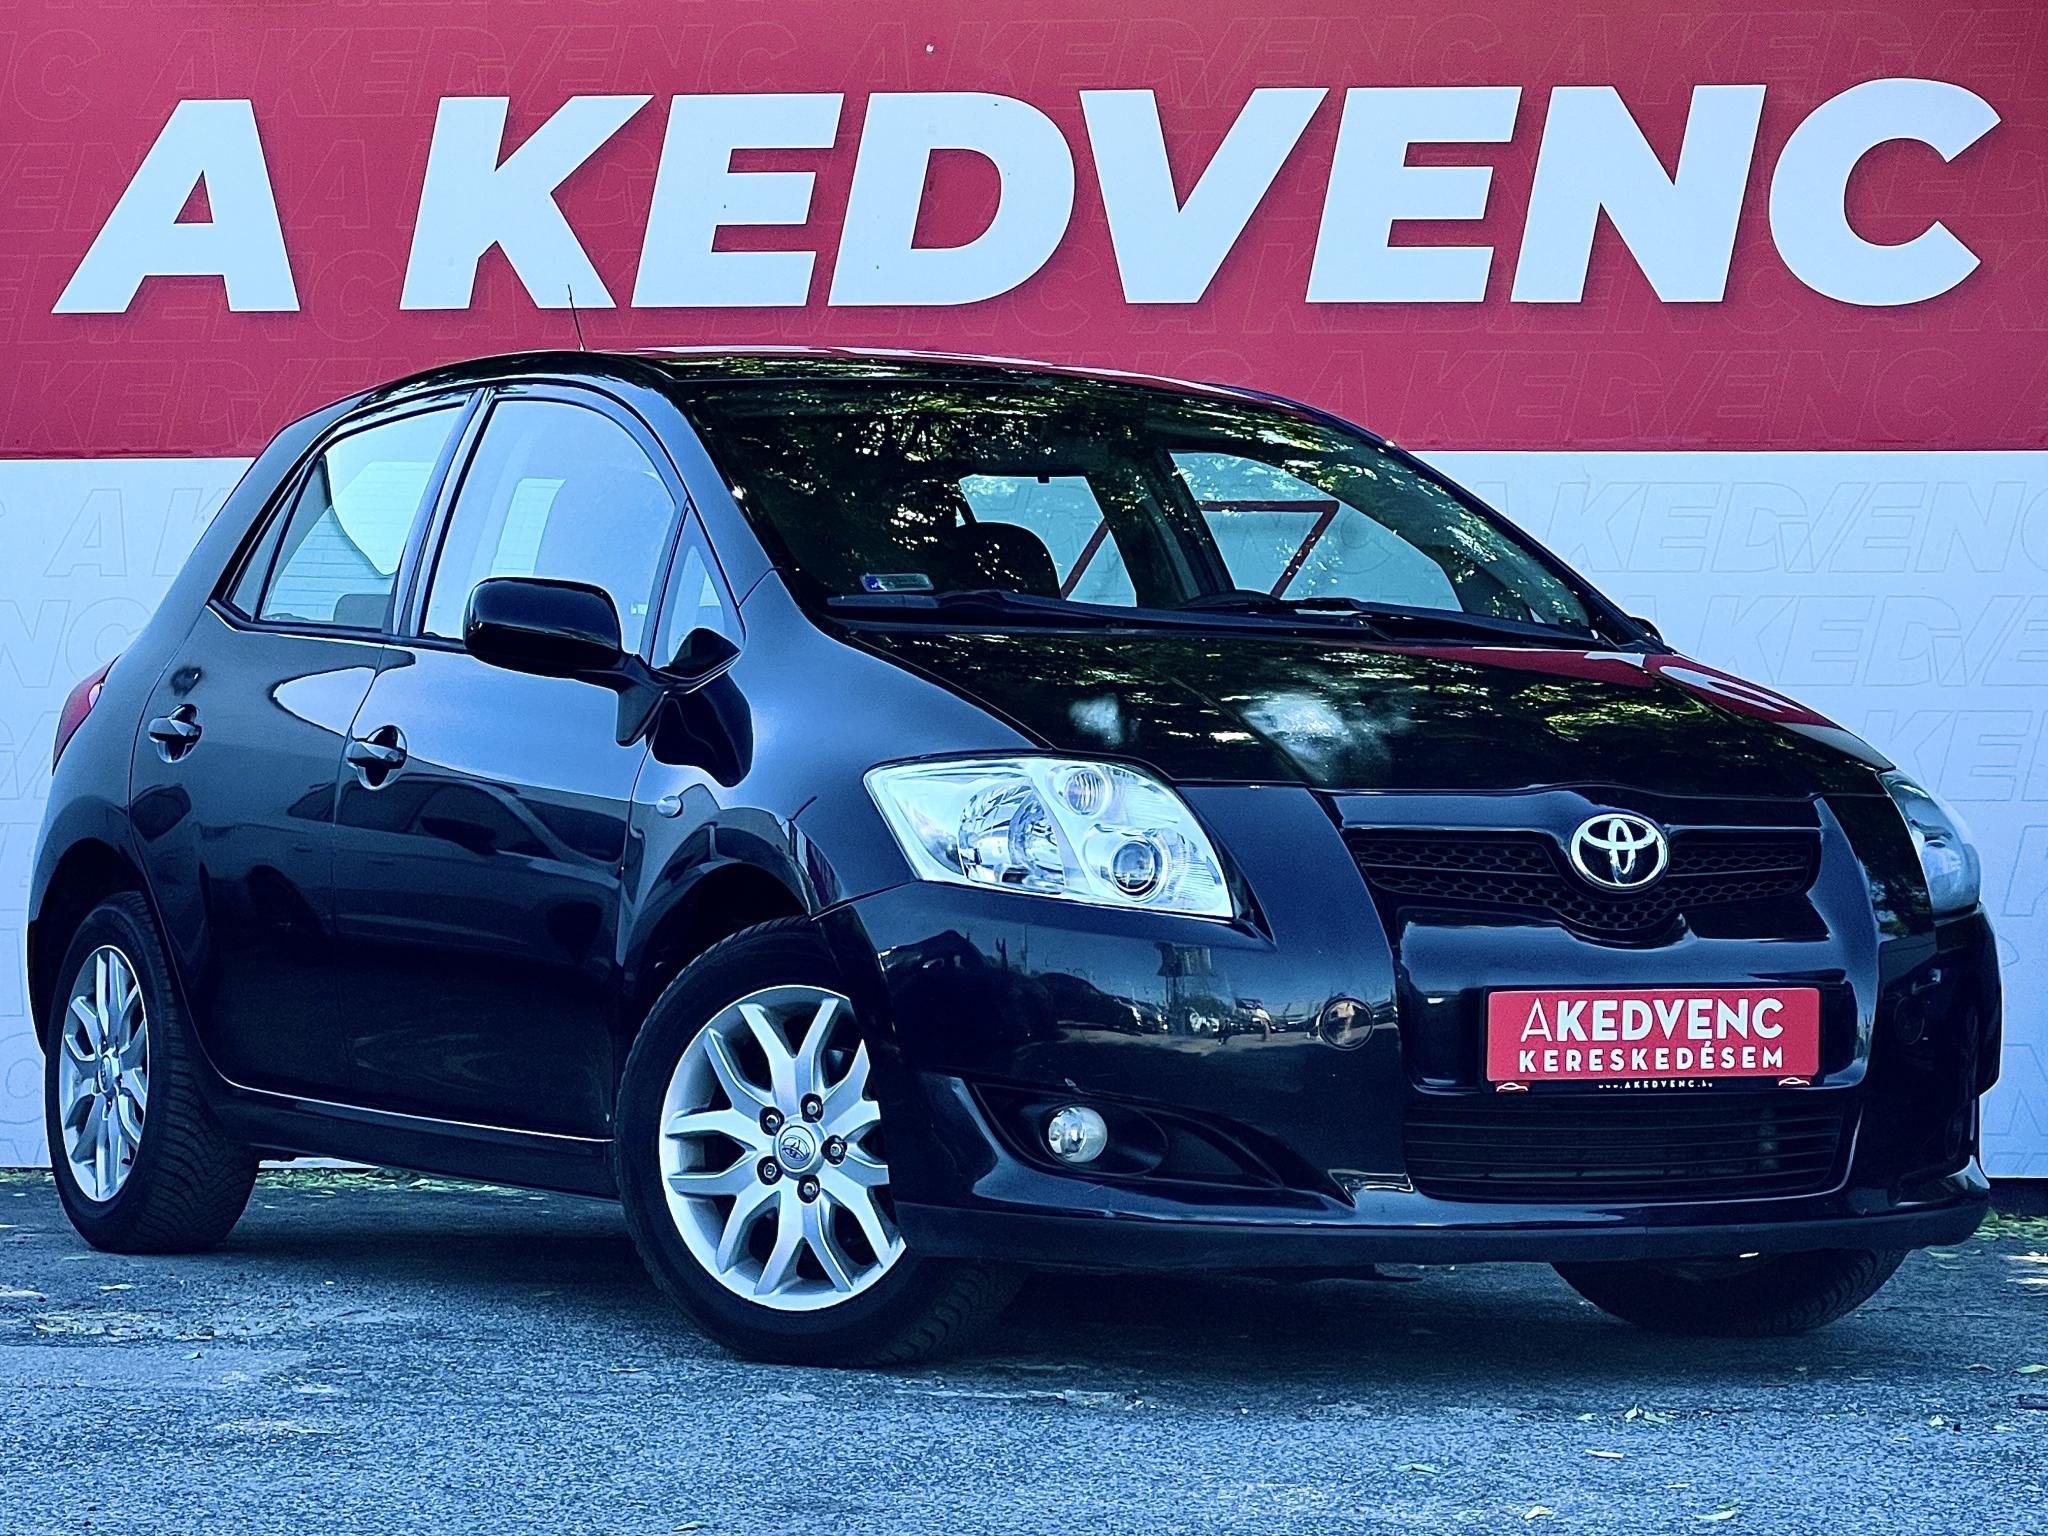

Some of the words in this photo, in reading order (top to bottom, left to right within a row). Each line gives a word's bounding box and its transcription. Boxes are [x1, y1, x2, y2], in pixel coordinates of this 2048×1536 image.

[52, 99, 300, 314] A
[400, 77, 2002, 308] KEDVENC
[1519, 1040, 1782, 1072] KERESKEDÉSEM
